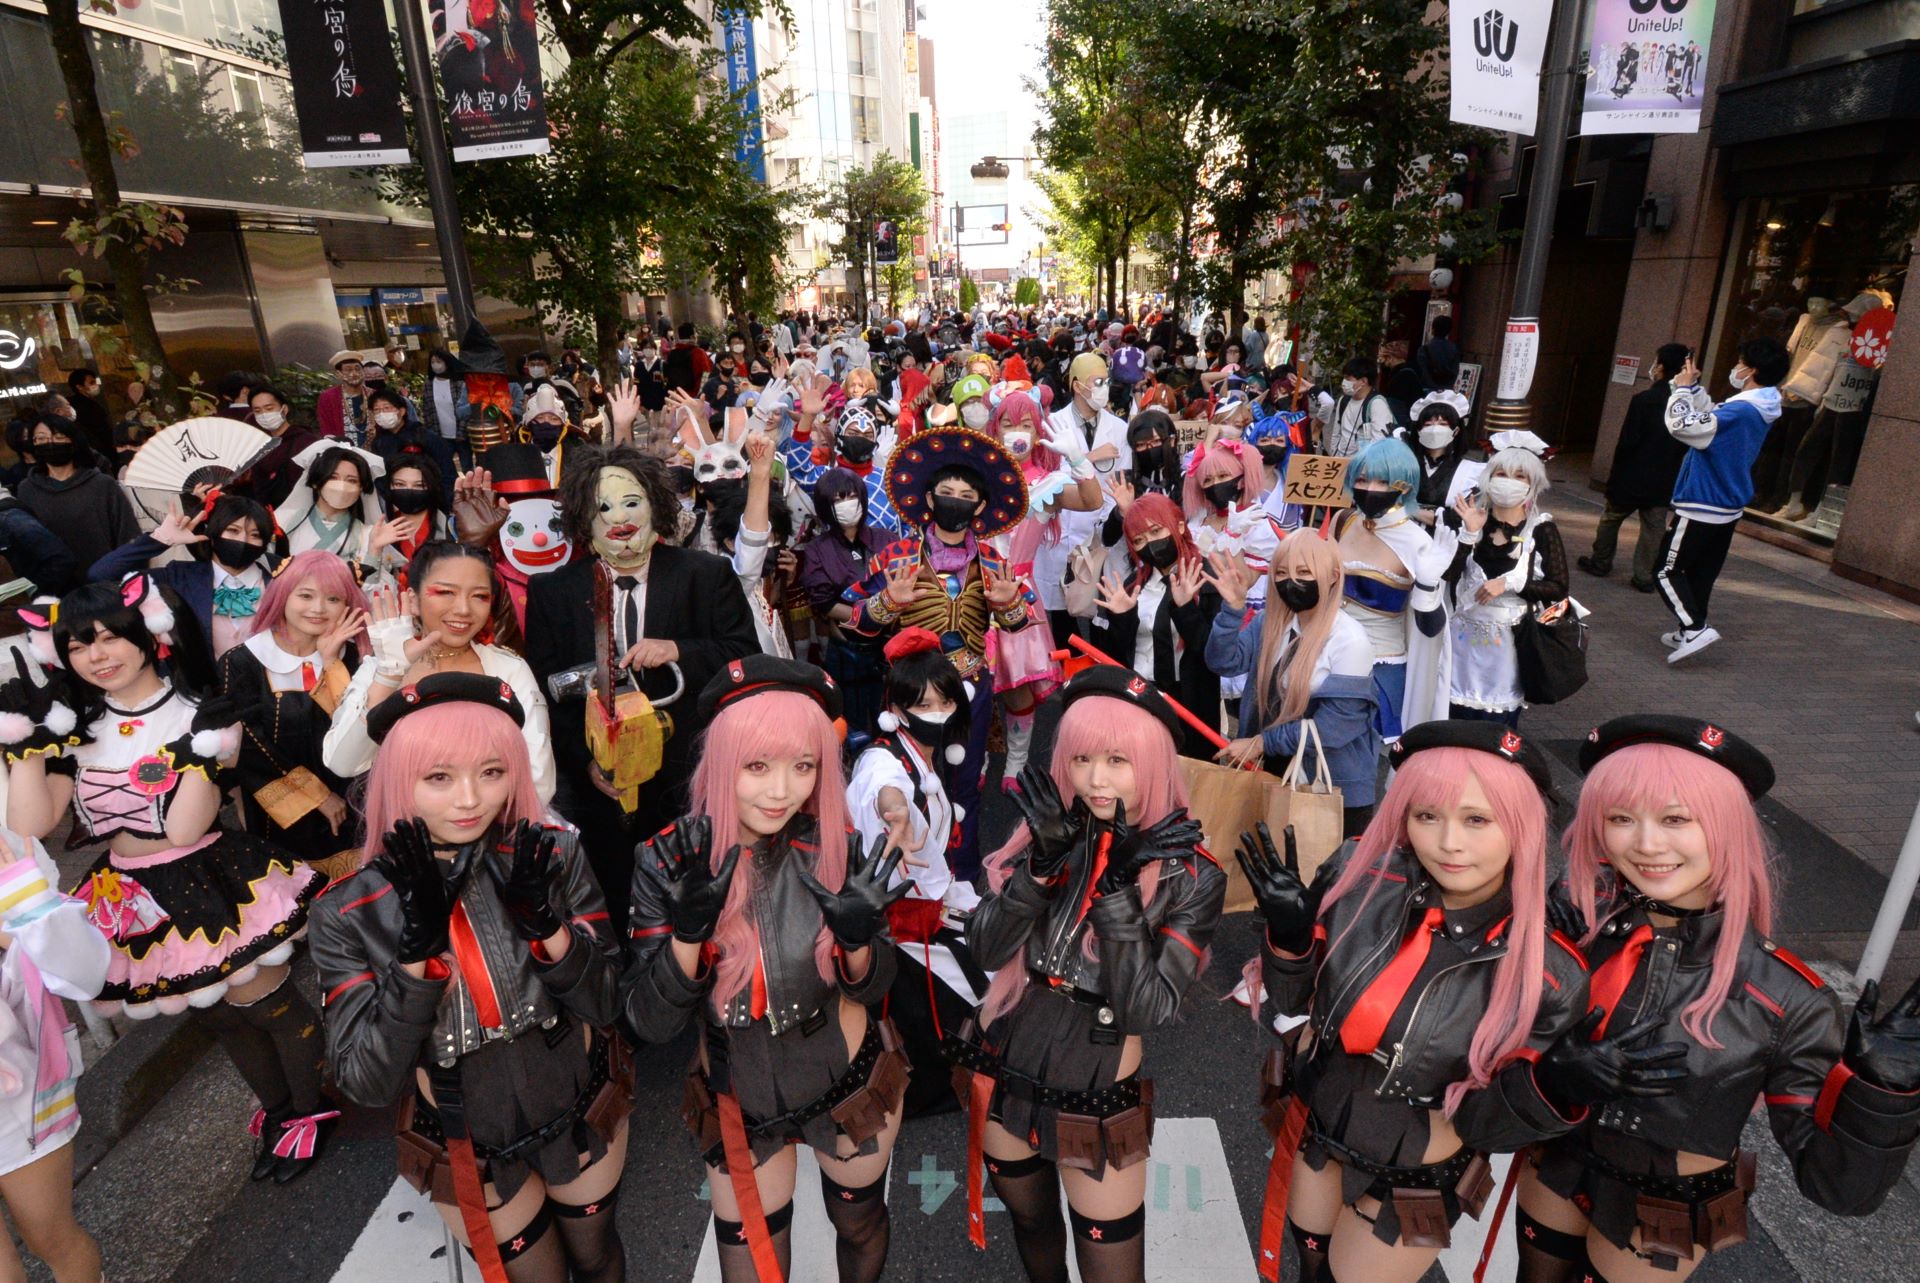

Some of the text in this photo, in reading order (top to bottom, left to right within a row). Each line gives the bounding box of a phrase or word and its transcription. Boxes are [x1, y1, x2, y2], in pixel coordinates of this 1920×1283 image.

[1628, 17, 1683, 33] UniteUp!
[314, 0, 357, 98] 宮の烏
[1476, 58, 1513, 78] UniteUp!
[451, 78, 531, 115] 後宮の烏
[967, 382, 977, 391] L
[1301, 458, 1342, 480] 妥当
